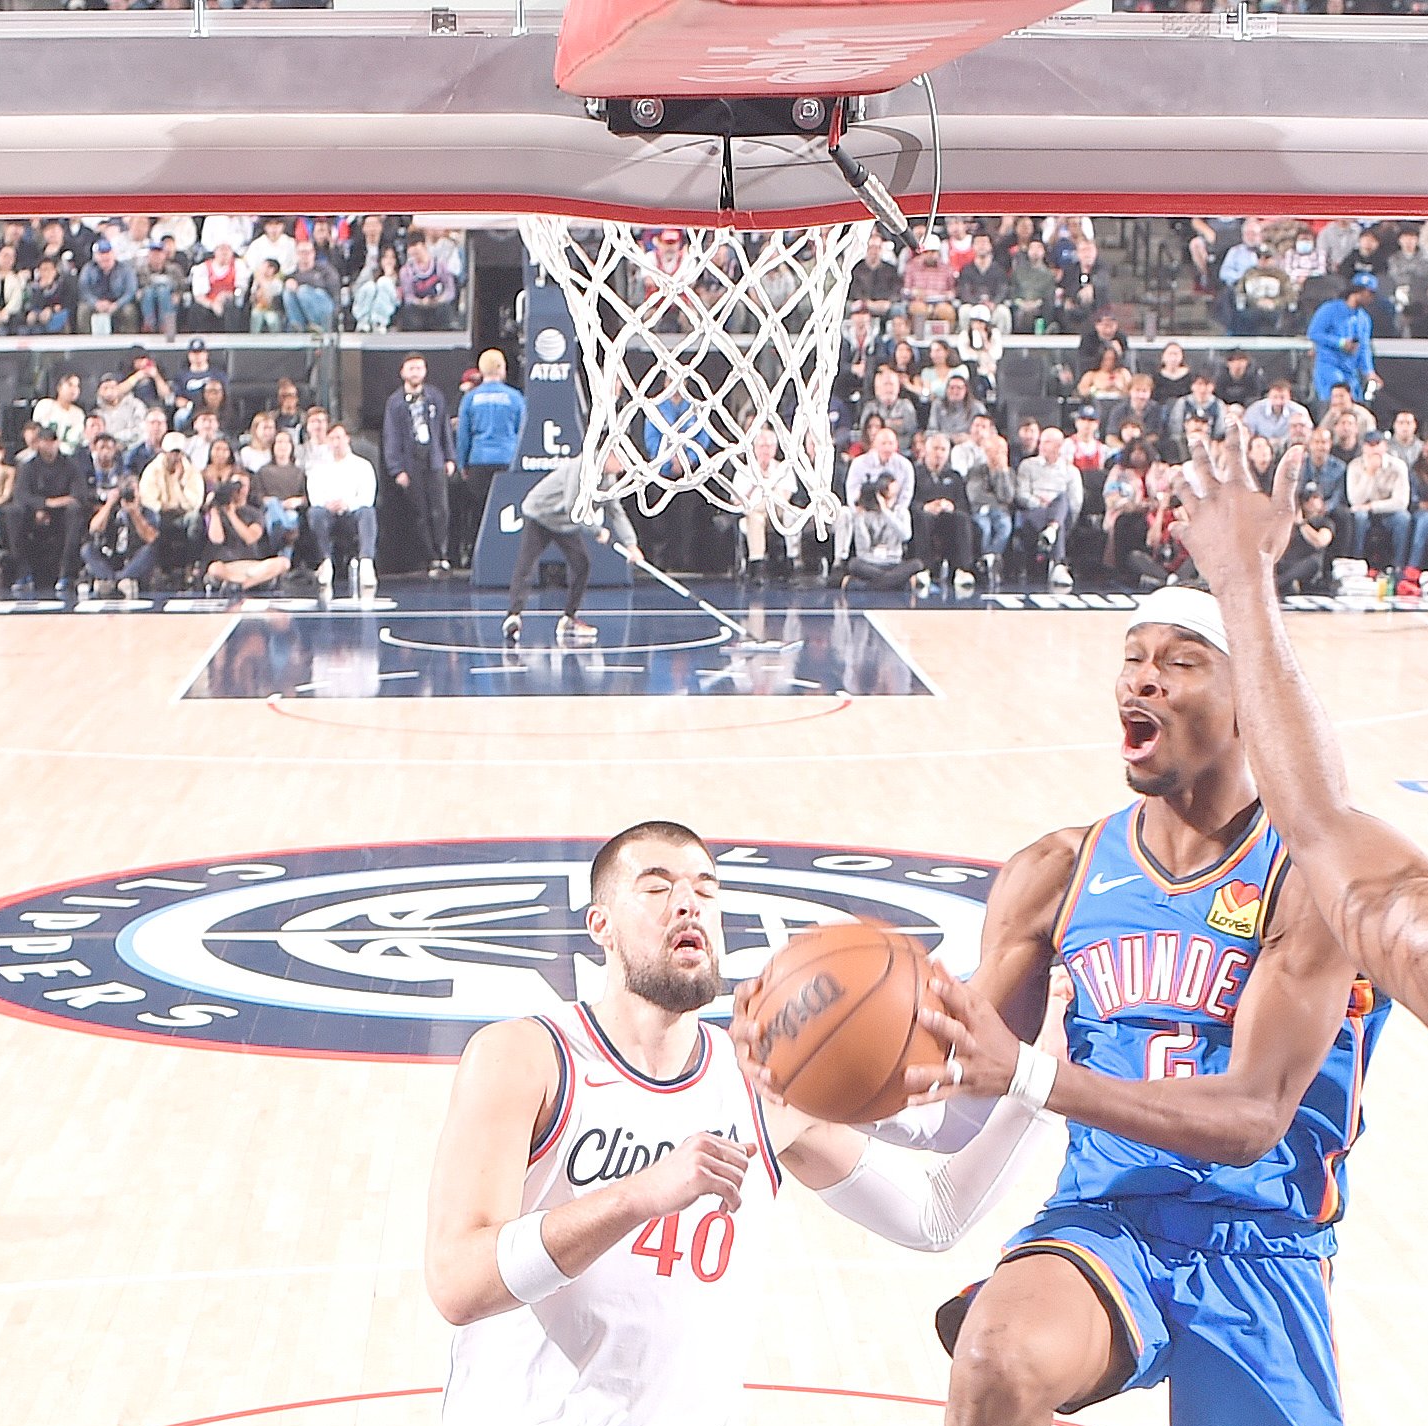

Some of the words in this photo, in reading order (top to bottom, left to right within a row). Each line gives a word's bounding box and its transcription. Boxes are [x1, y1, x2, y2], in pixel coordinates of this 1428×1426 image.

[529, 363, 572, 381] AT&T
[1209, 910, 1252, 934] Love's
[1068, 930, 1251, 1022] THUNDE
[566, 1122, 739, 1187] Clip
[630, 1209, 736, 1283] 40
